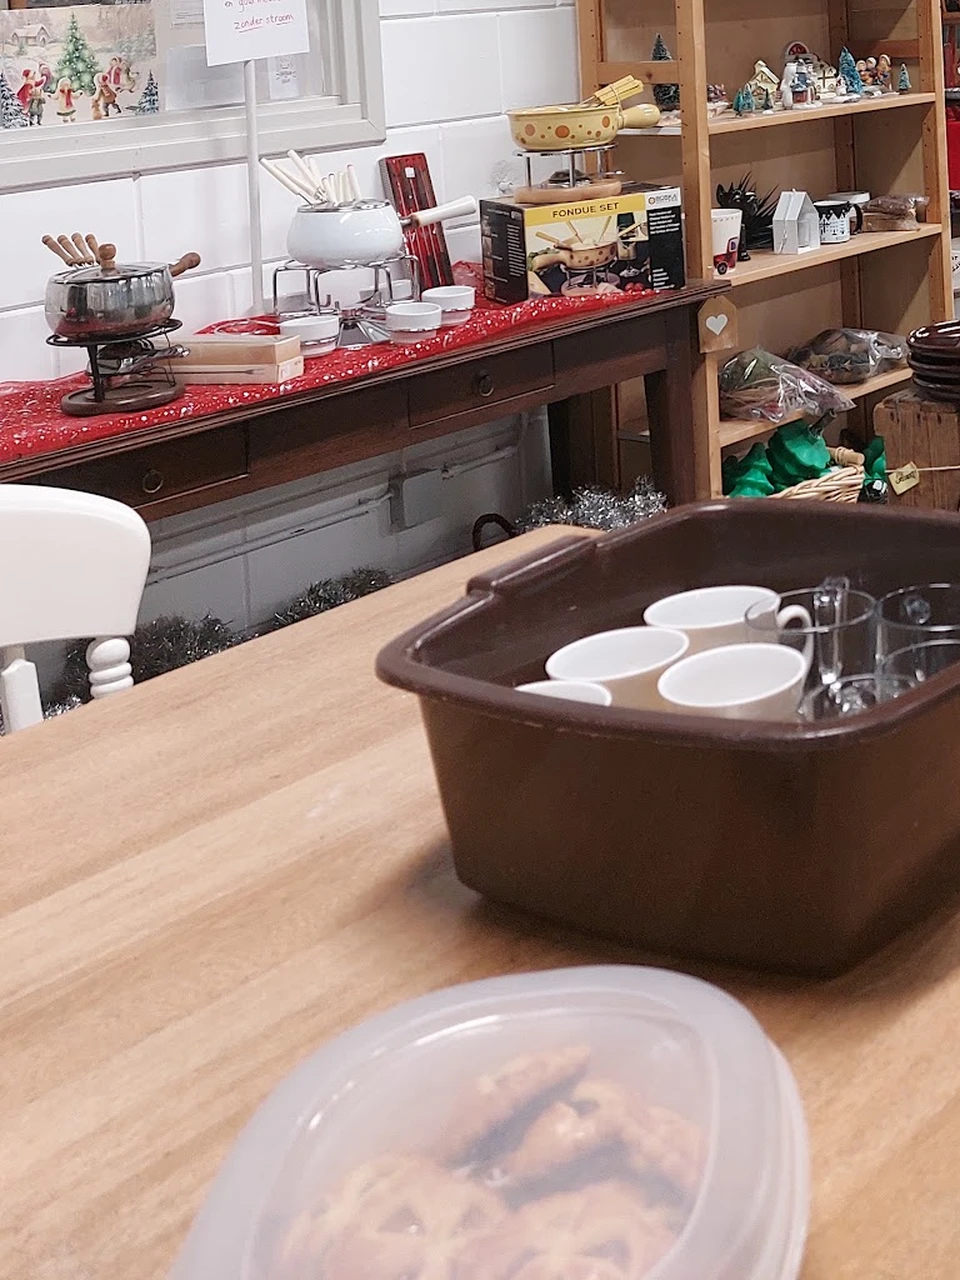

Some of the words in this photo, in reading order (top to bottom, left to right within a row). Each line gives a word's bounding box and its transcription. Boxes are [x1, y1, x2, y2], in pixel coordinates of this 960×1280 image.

[233, 16, 263, 30] zonder
[265, 14, 294, 24] stroom
[552, 205, 597, 218] FONDUE
[599, 202, 619, 212] SET
